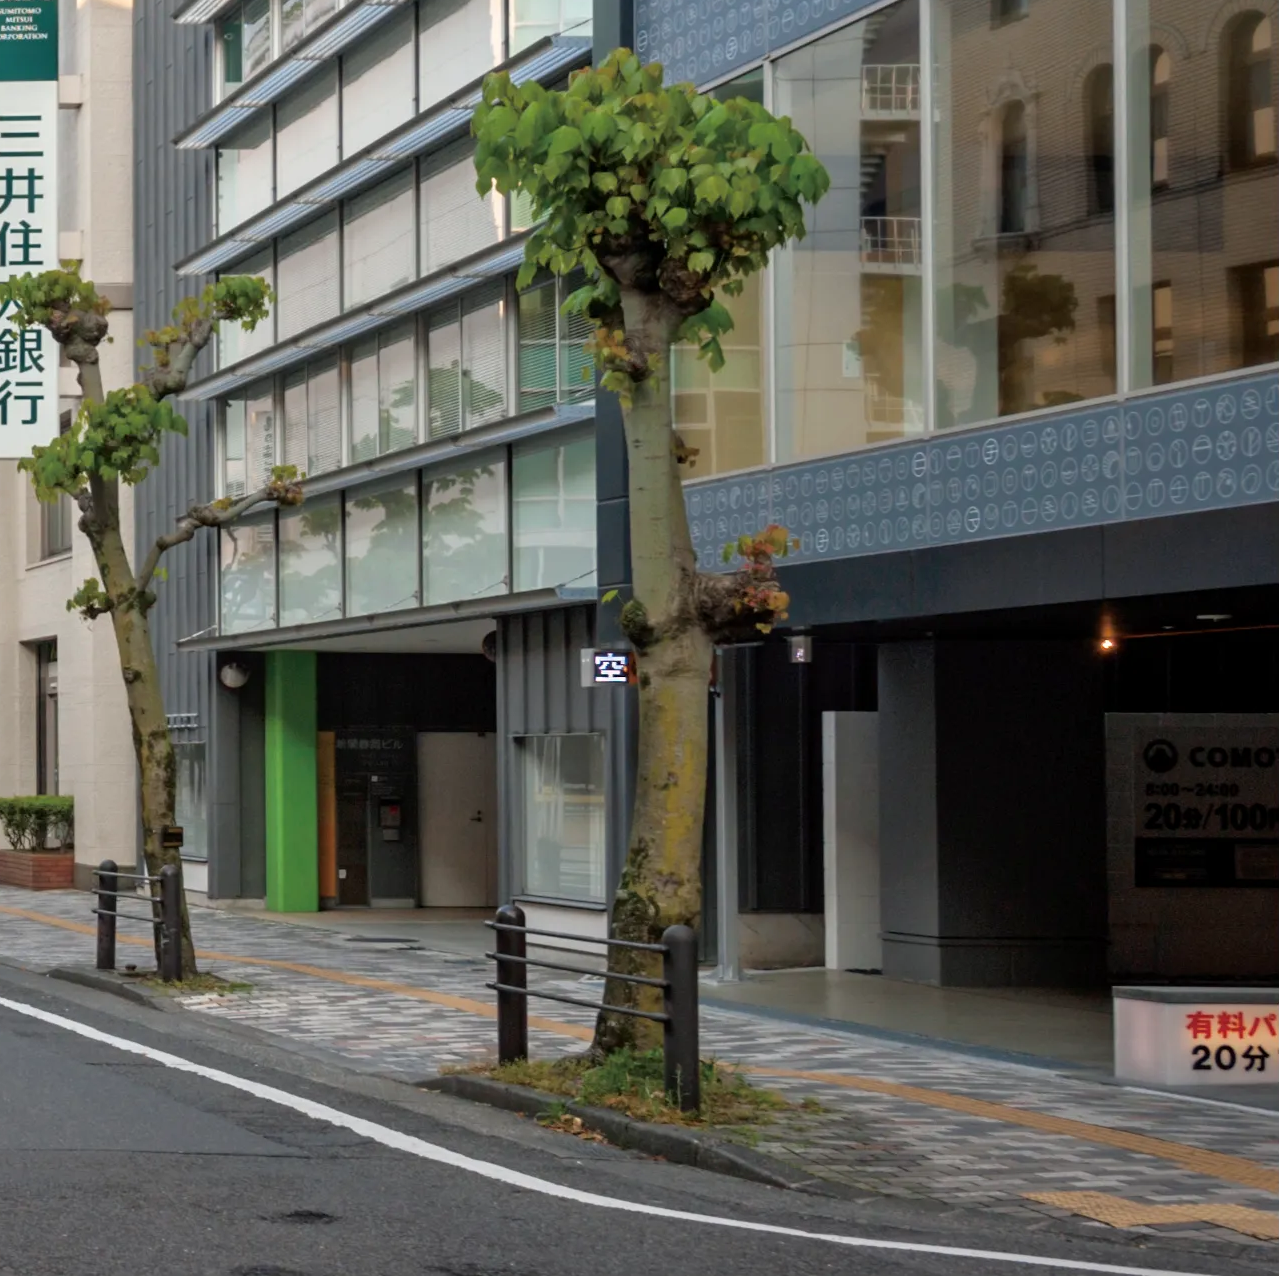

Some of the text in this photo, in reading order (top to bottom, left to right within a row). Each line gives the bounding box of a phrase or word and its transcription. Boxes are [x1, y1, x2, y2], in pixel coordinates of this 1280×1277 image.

[0, 24, 38, 32] BANKING
[5, 16, 33, 24] MITSUI
[1185, 1011, 1278, 1040] 有料パ
[1191, 1045, 1270, 1072] 20分
